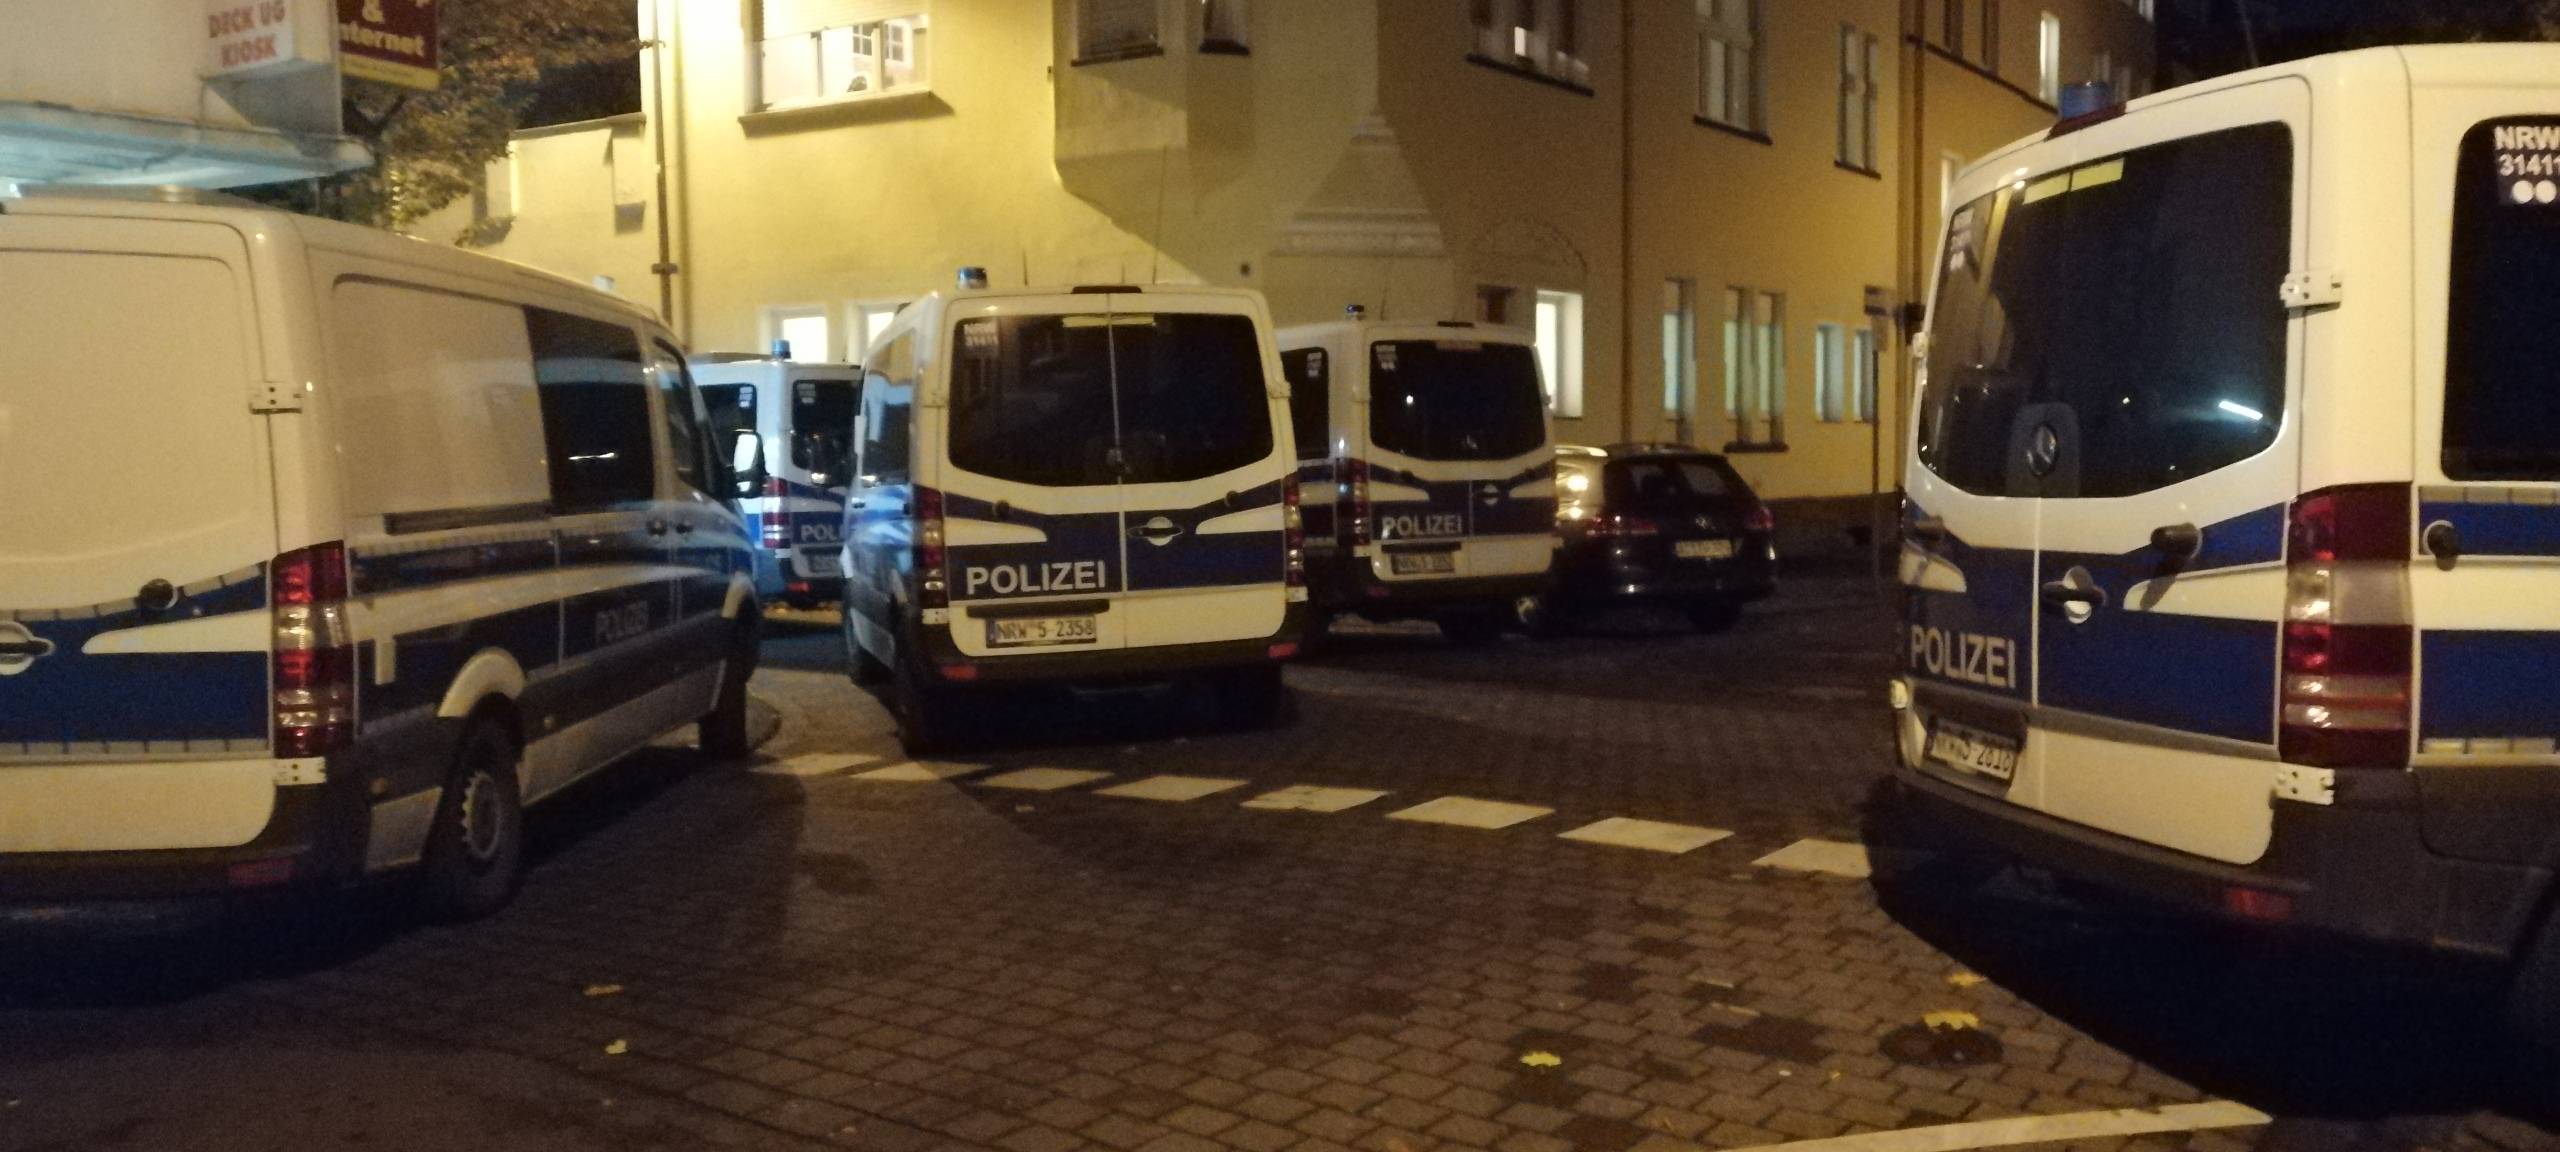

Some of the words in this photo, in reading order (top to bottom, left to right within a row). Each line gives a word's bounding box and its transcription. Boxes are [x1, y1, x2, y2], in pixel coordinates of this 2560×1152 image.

[339, 21, 425, 57] nternet
[2494, 126, 2560, 150] NRW
[1381, 514, 1463, 538] POLIZEI
[966, 560, 1105, 594] POLIZEI
[1910, 624, 2016, 689] POLIZEI
